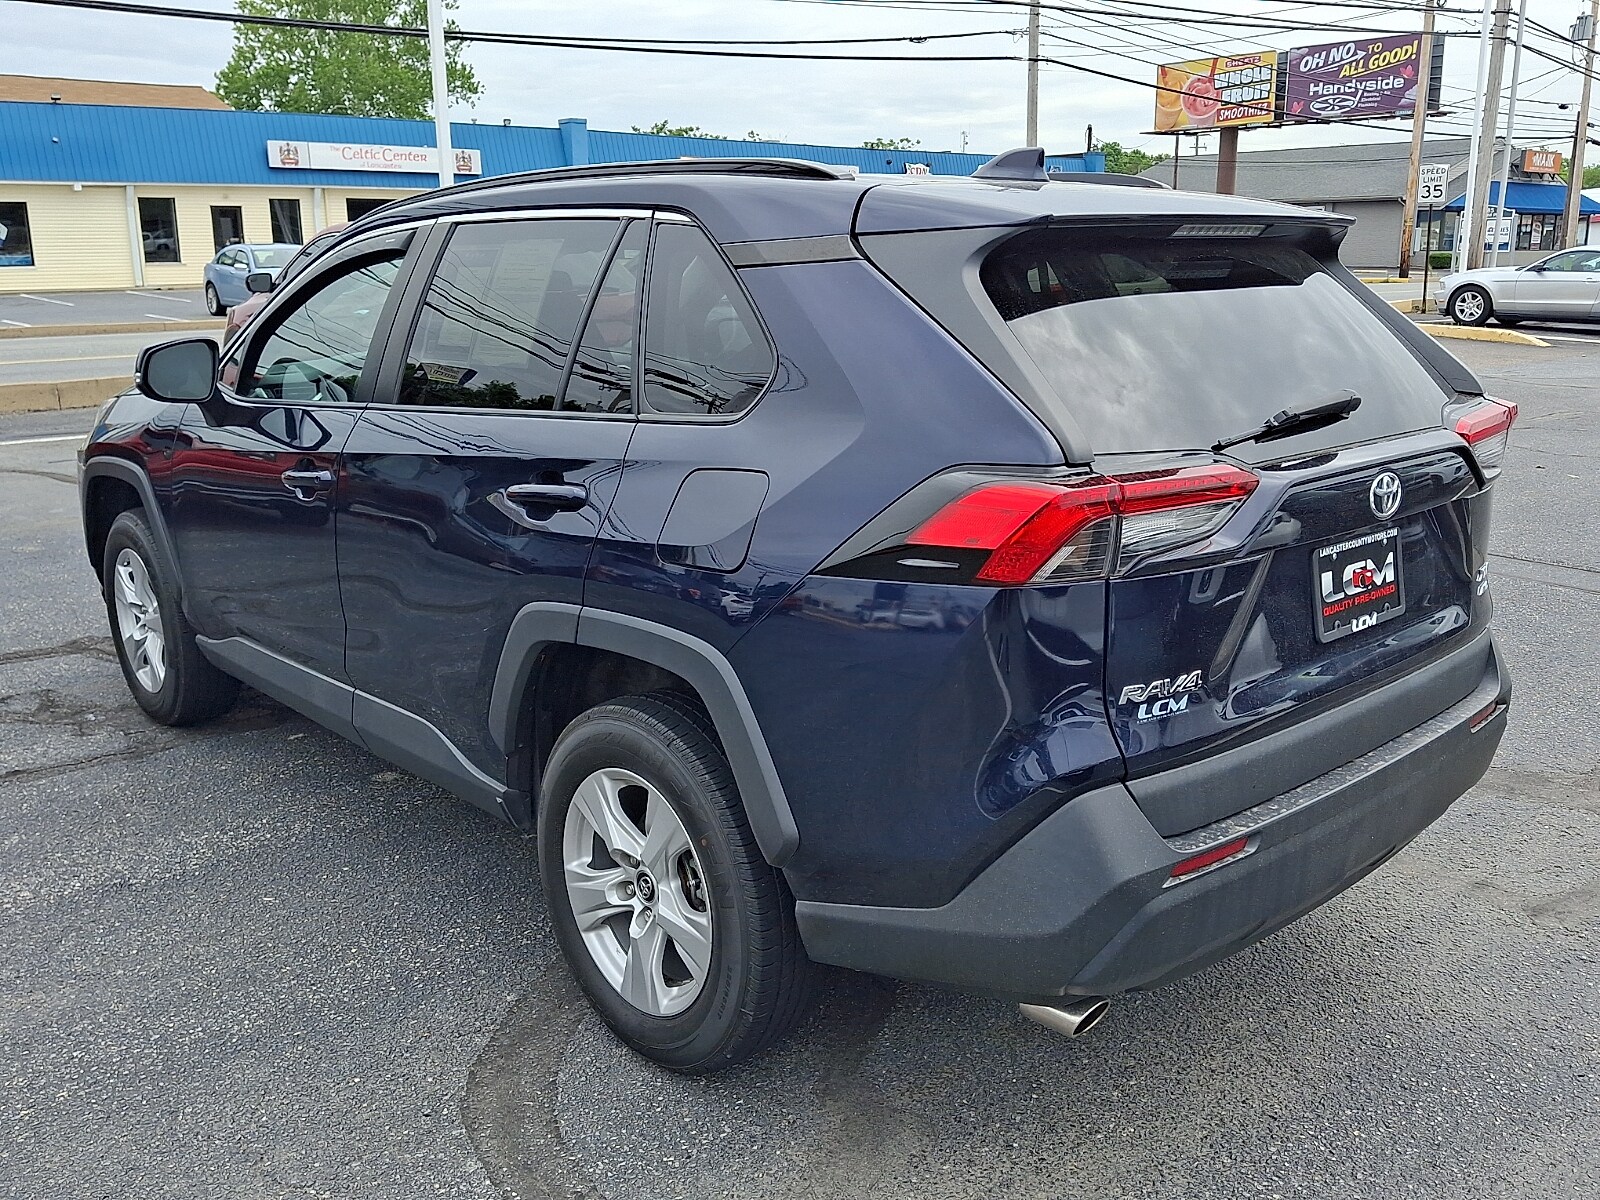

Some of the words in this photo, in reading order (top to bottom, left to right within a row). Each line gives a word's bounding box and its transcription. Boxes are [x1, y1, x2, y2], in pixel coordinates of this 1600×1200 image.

[1300, 51, 1325, 72] OH
[1328, 43, 1355, 64] NO
[1339, 59, 1366, 78] ALL
[1369, 40, 1419, 70] GOOD!
[1368, 42, 1382, 54] TO
[1214, 64, 1273, 89] WHOLE
[1309, 76, 1405, 96] Handyside
[1221, 82, 1272, 106] FRUIT
[341, 146, 381, 160] Celtic
[382, 148, 428, 162] Center
[1421, 167, 1447, 176] SPEED
[1422, 176, 1442, 184] LIMIT
[1421, 184, 1443, 199] 35
[1323, 599, 1354, 617] QUALITY
[1354, 584, 1396, 605] PRE-OWNED
[1351, 611, 1378, 633] LCM
[1118, 669, 1203, 705] RAV4
[1137, 694, 1189, 720] LCM
